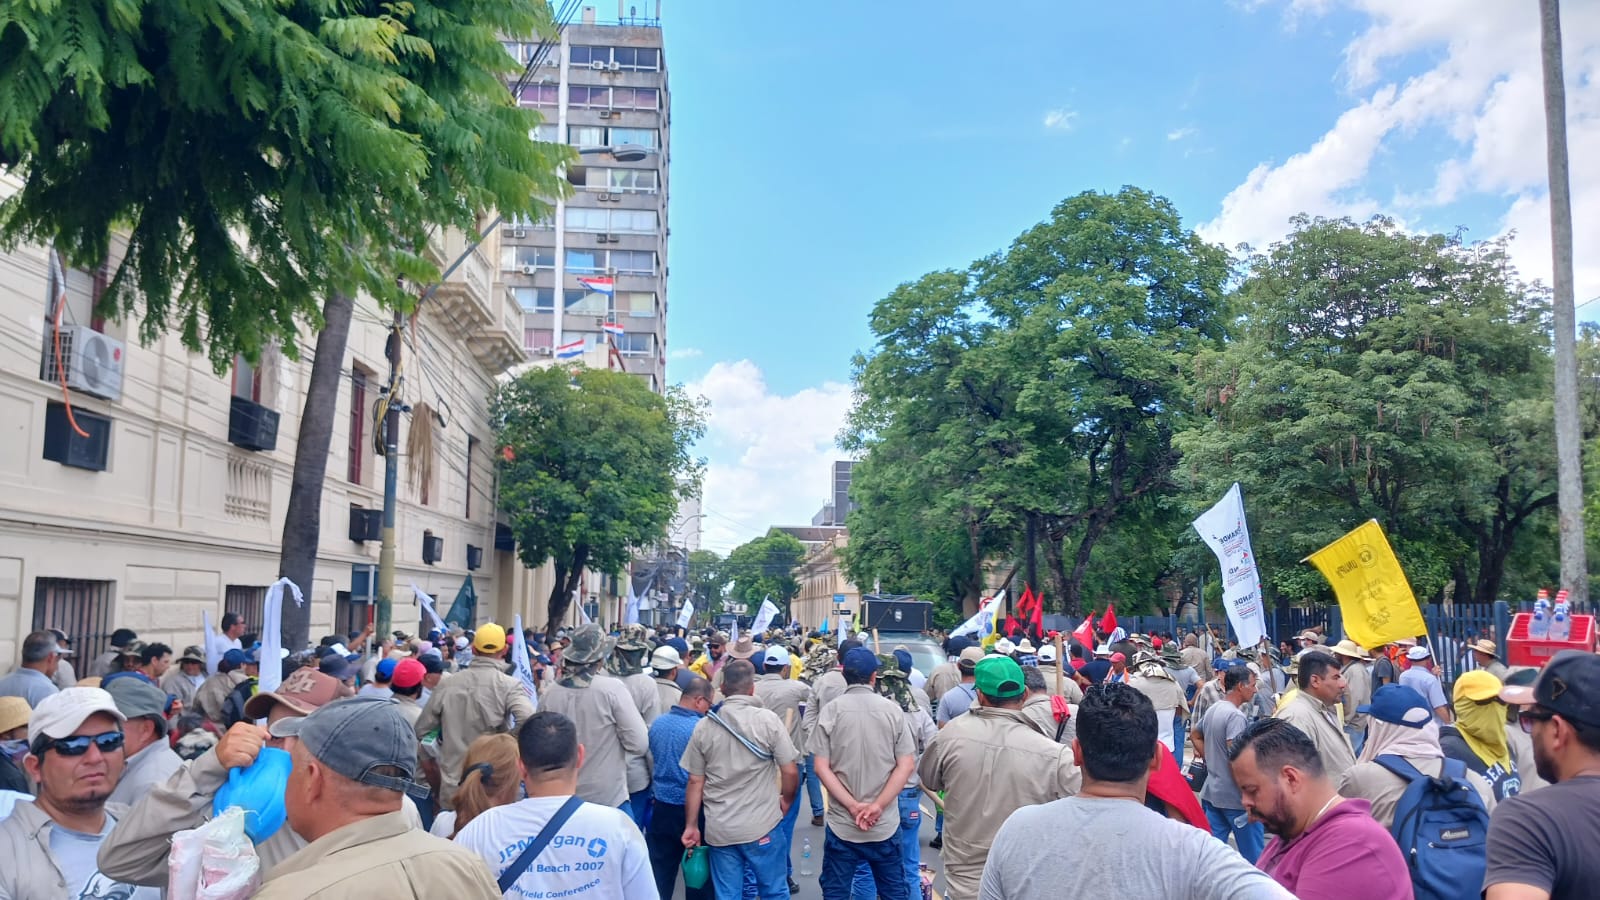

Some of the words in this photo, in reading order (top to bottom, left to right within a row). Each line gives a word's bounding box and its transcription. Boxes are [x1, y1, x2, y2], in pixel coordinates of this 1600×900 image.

[499, 835, 585, 863] JPMgan
[536, 863, 570, 873] Beach
[574, 862, 604, 871] 2007
[546, 878, 600, 898] Conference
